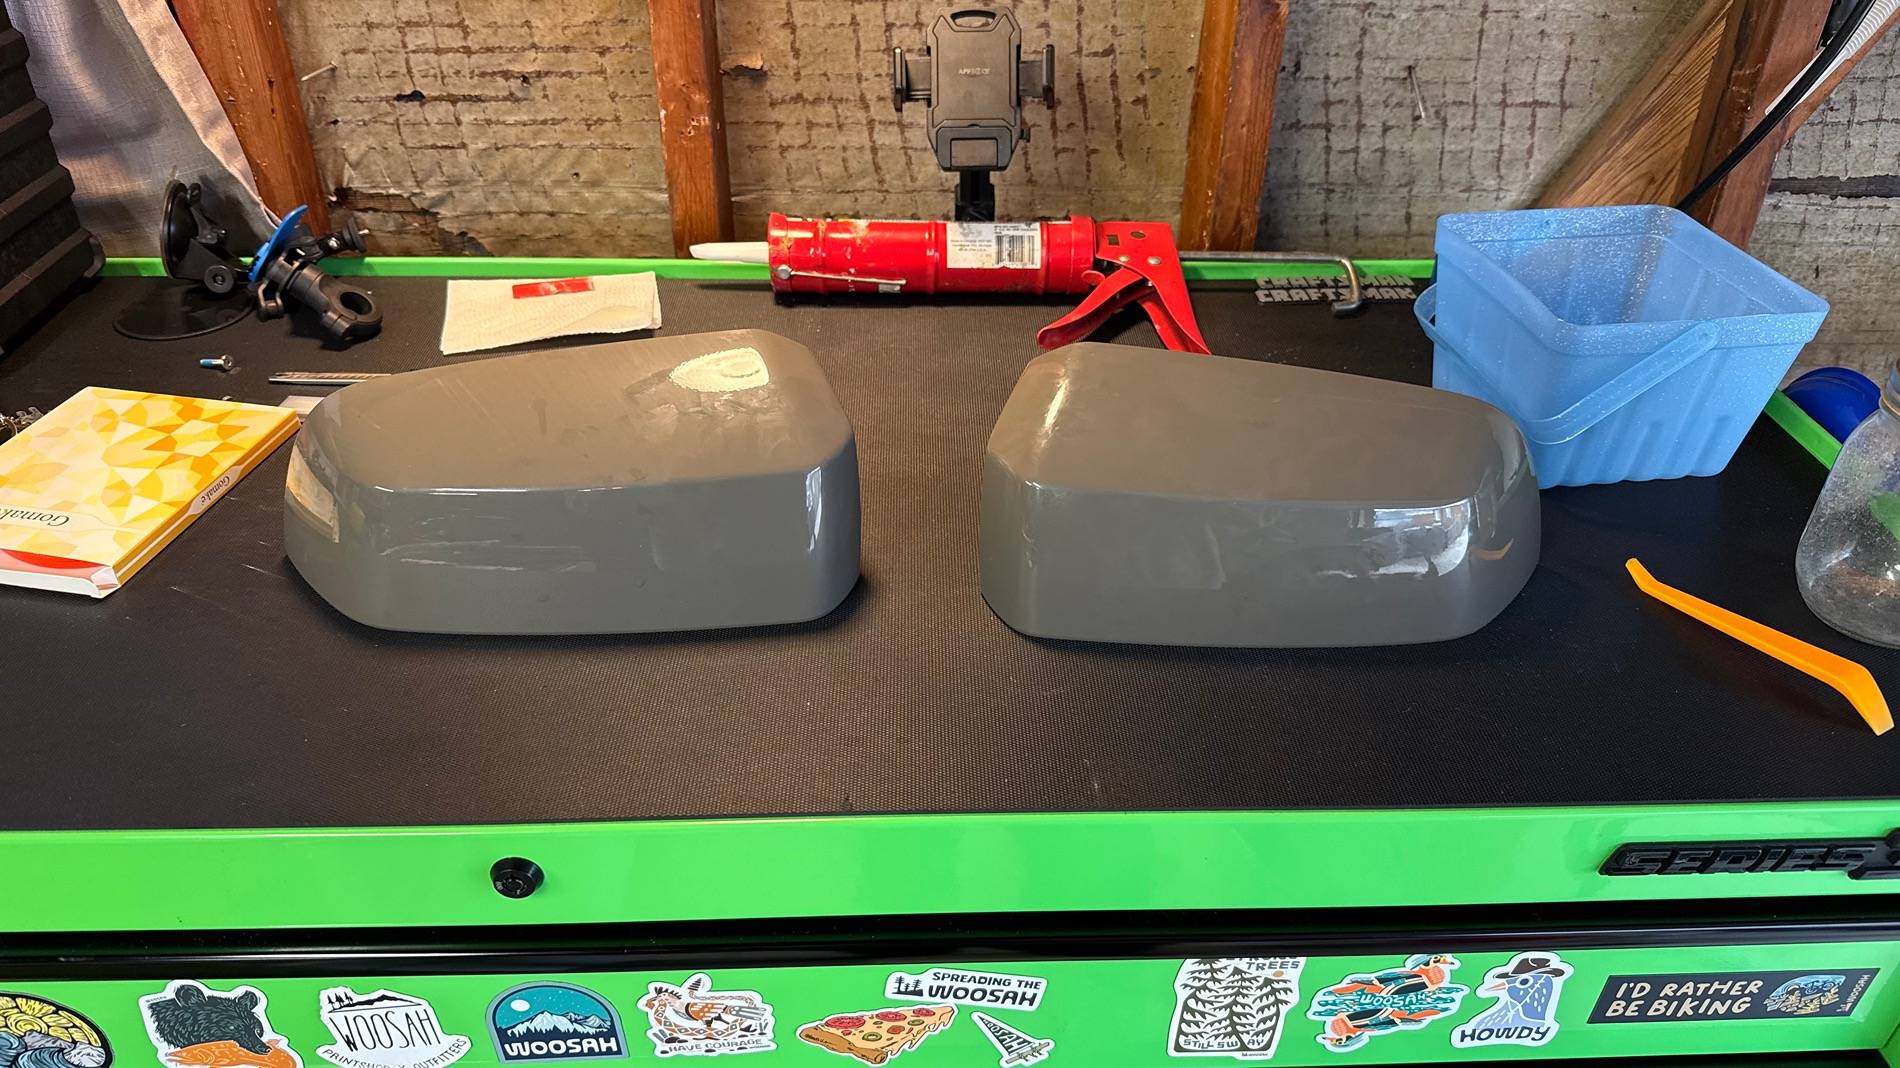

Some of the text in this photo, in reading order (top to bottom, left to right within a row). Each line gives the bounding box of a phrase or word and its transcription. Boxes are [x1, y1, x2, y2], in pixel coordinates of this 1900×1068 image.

[1255, 288, 1417, 302] CRAFTSMAN
[200, 476, 230, 505] Gomake
[0, 508, 70, 527] Gomak
[1603, 841, 1876, 875] SERIES
[1246, 960, 1300, 972] TREES
[932, 971, 1041, 990] SPREADING THE
[1616, 980, 1764, 999] I'D RATHER
[1848, 974, 1871, 1006] WOOSAH
[928, 984, 1037, 1007] WOOSAH
[1360, 994, 1425, 1007] WOOSAH
[1606, 997, 1751, 1017] BE BIKING
[329, 1009, 440, 1052] WOOSAH
[1460, 1026, 1551, 1042] HOWDY
[504, 1037, 618, 1056] WOOSAH
[668, 1043, 703, 1053] HAVE
[705, 1039, 763, 1050] COURAGE
[1184, 1038, 1214, 1049] STILL
